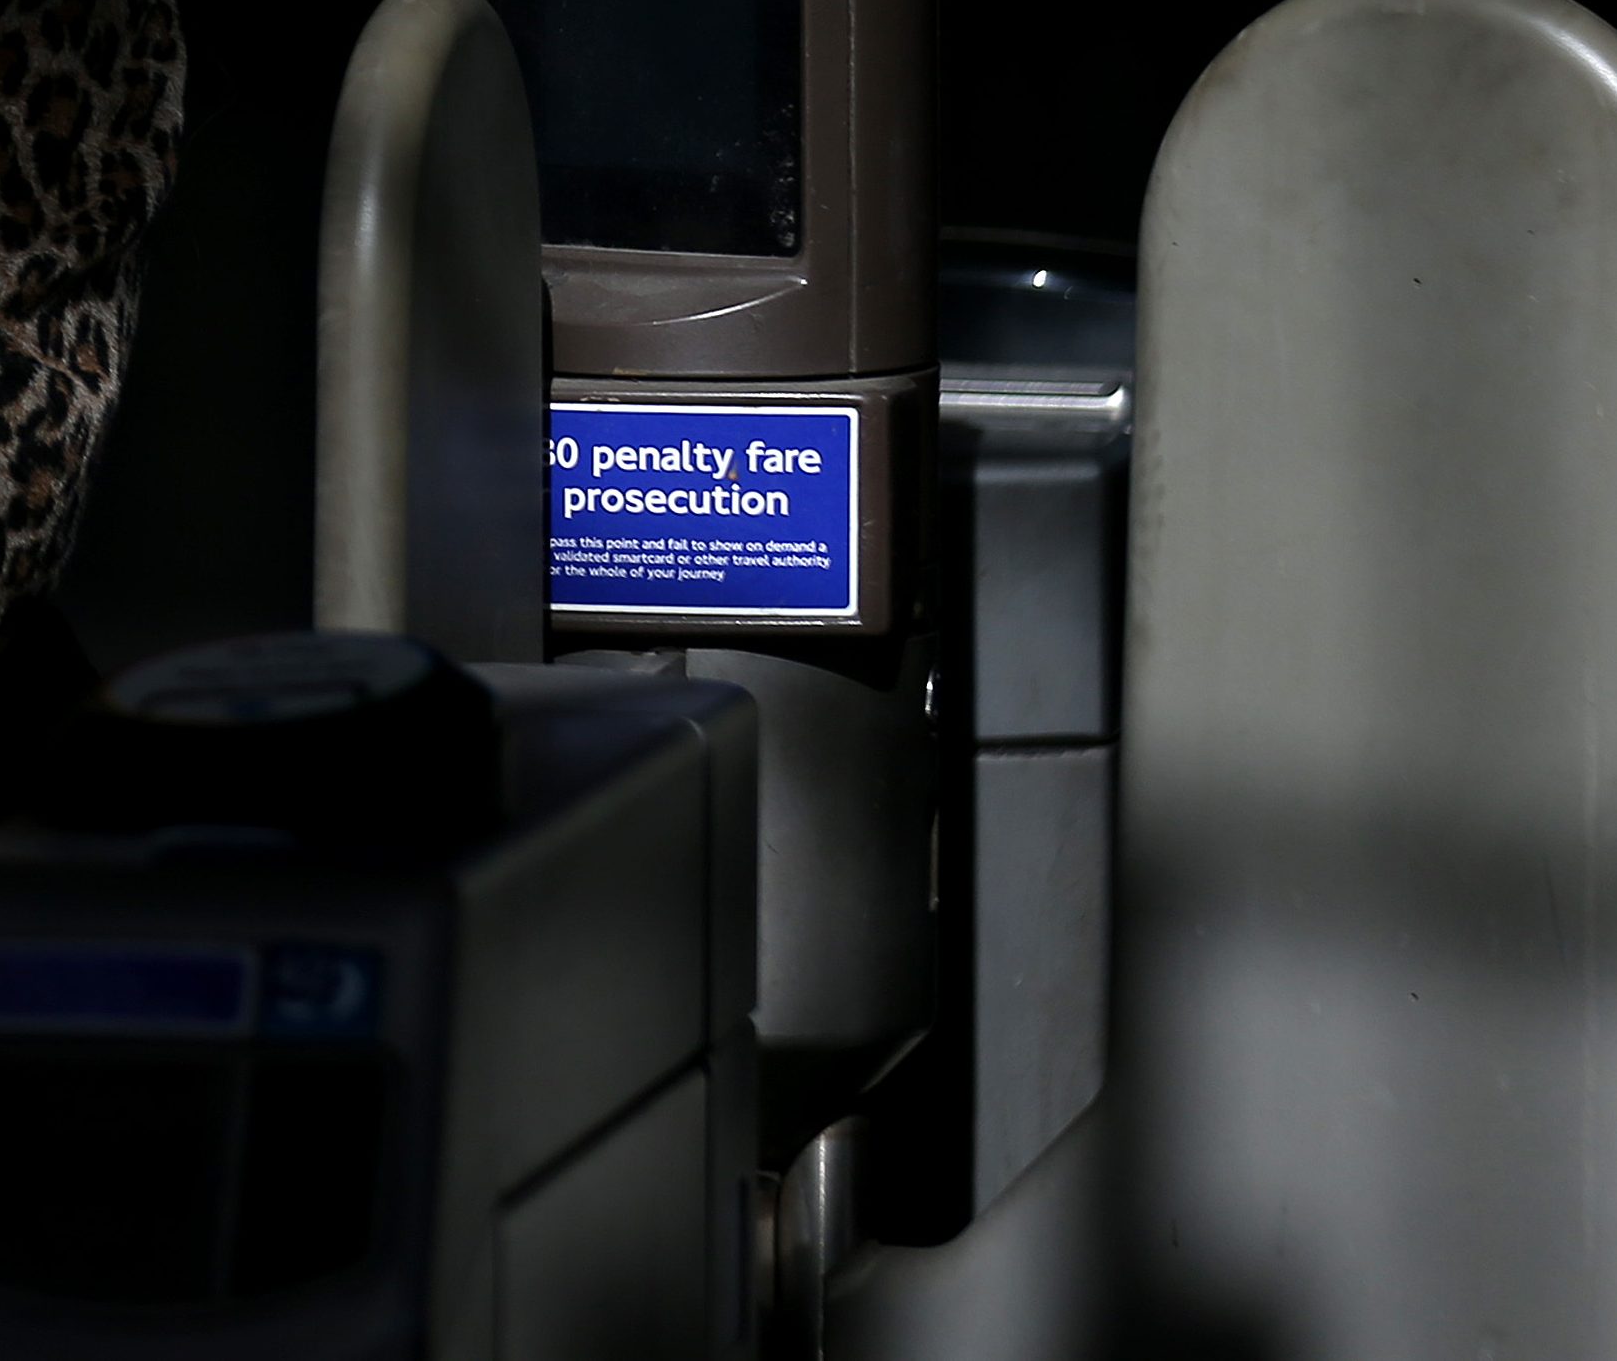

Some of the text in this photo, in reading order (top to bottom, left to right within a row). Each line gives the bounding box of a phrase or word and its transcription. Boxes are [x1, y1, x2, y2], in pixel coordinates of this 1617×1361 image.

[592, 439, 734, 480] penalty
[746, 440, 822, 473] fare
[564, 483, 789, 519] prosecution
[550, 536, 827, 553] pass this point and fail to show on demand a
[553, 550, 831, 570] validated smartcard or other travel authority
[564, 564, 587, 577] the
[588, 565, 628, 578] whole
[629, 566, 645, 578] of
[647, 568, 676, 580] your
[677, 566, 725, 583] journey
